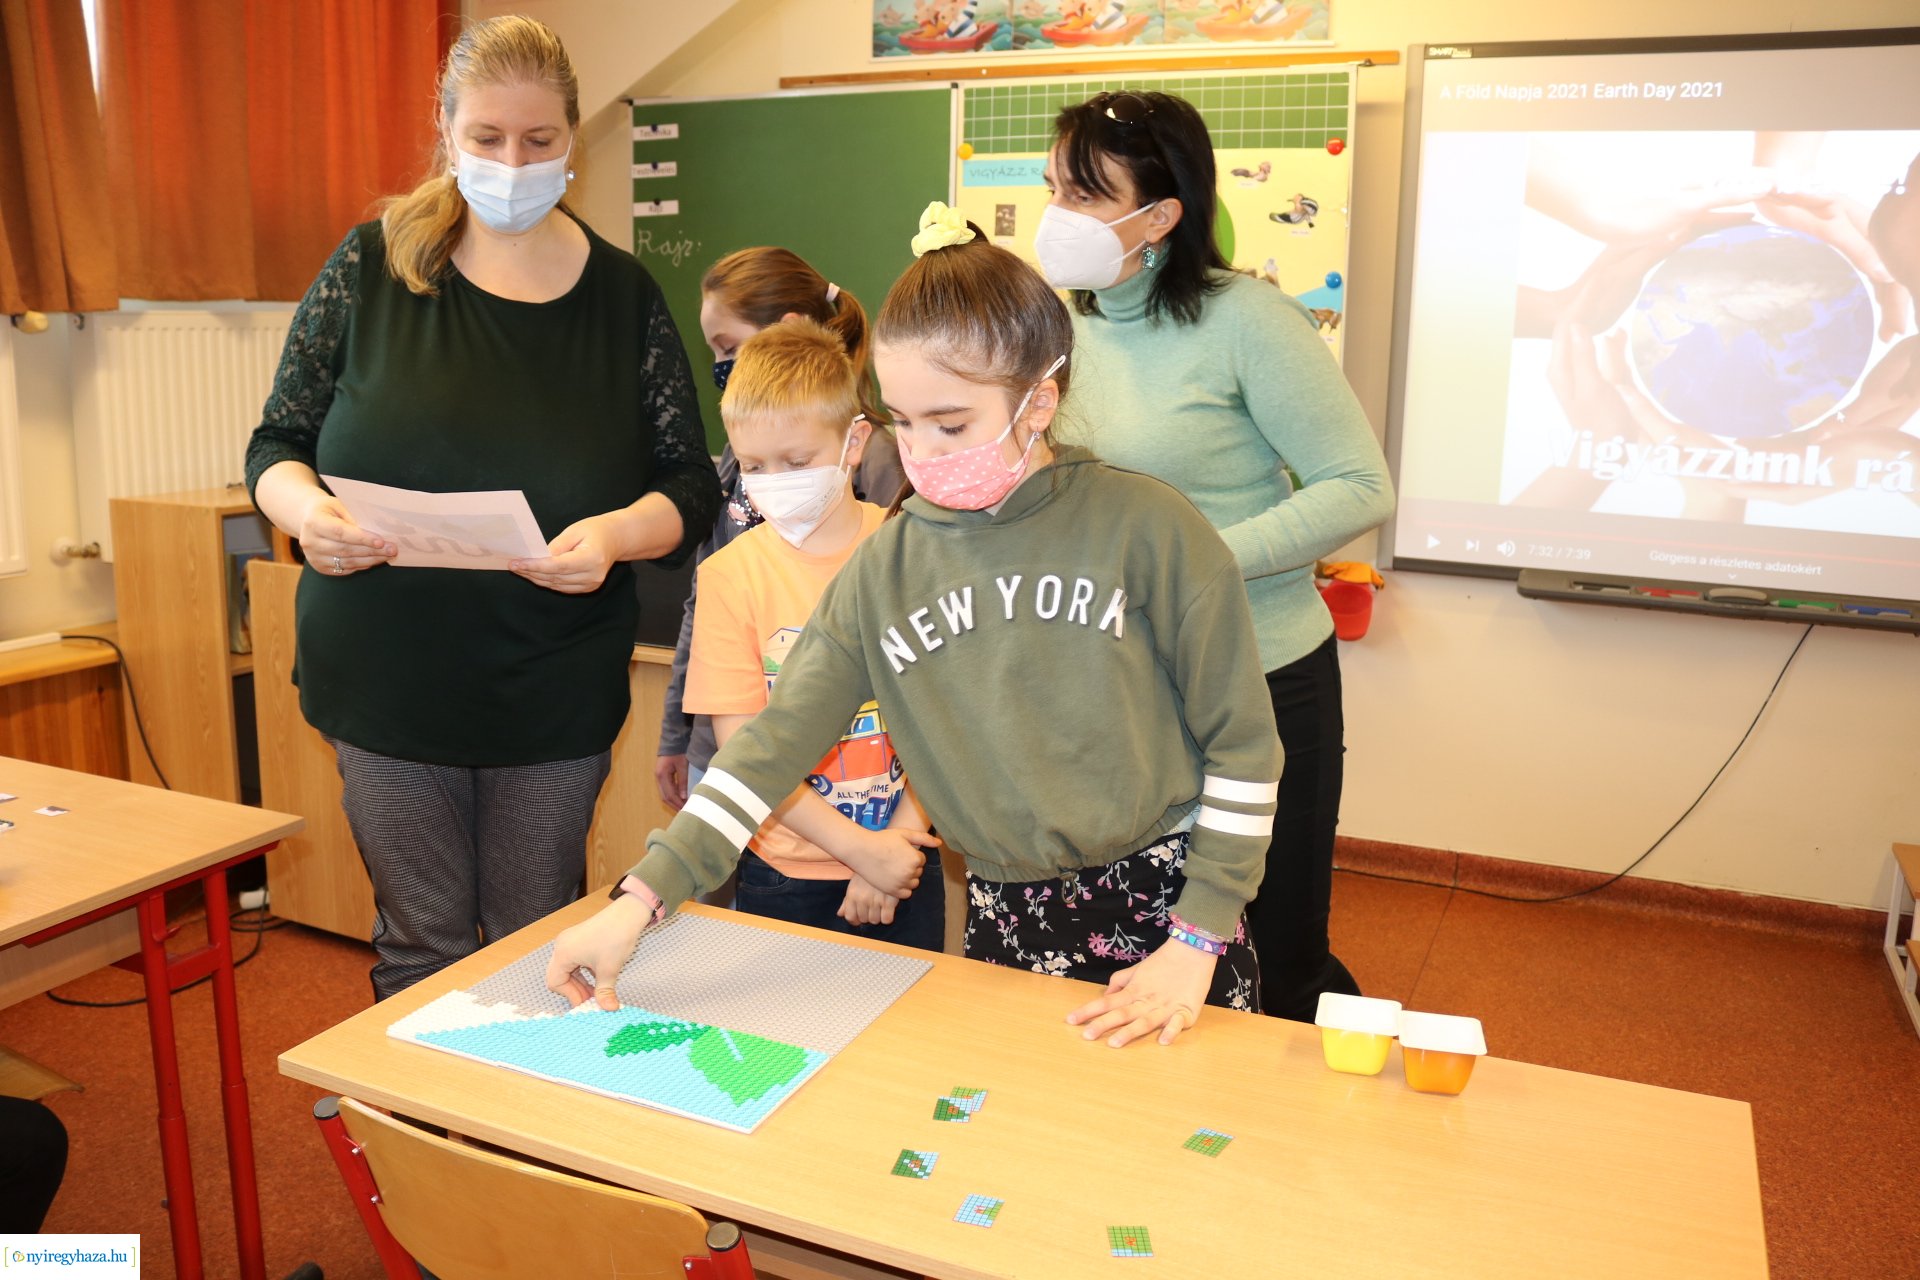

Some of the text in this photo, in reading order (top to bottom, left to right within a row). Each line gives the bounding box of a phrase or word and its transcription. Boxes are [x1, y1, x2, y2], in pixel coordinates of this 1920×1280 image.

[1439, 81, 1723, 103] A Föld Napja 2021 Earth Day 2021
[1855, 451, 1916, 494] rá
[1527, 544, 1554, 558] 7:32
[1565, 546, 1592, 561] 7:39
[1699, 556, 1708, 566] a
[1709, 554, 1762, 571] részletes
[1764, 558, 1823, 576] adatokért
[879, 574, 1129, 675] NEW YORK
[837, 791, 854, 799] ALL
